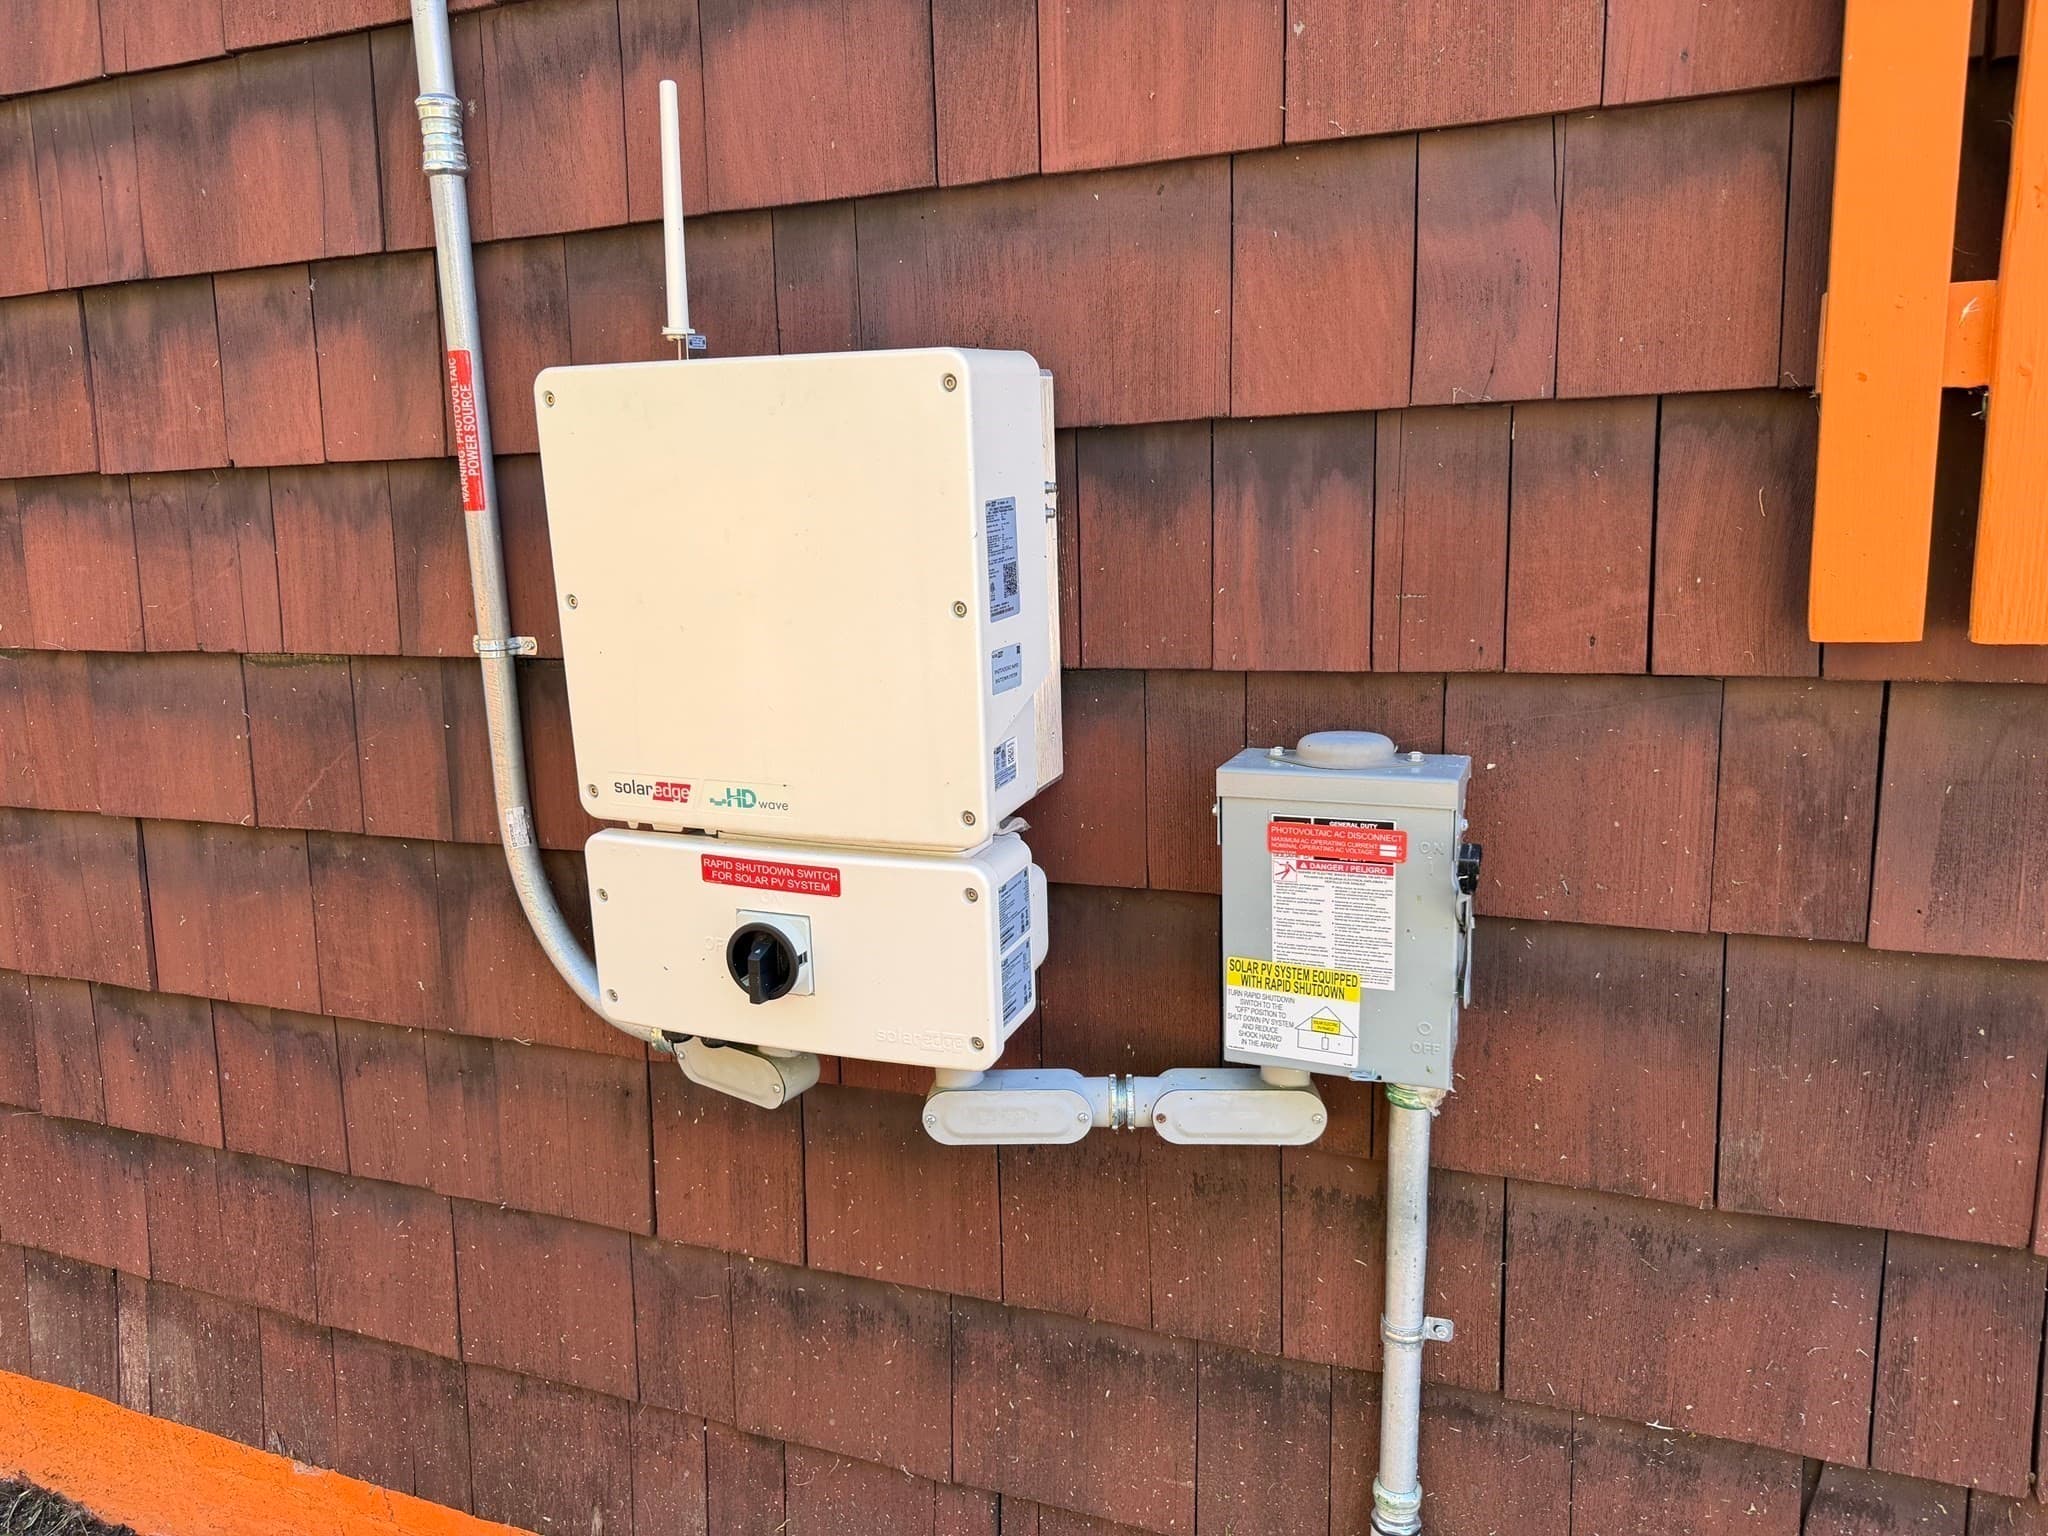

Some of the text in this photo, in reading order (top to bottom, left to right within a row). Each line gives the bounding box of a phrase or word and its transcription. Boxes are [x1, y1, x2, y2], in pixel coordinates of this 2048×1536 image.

[448, 357, 471, 502] WARNING: PHOTOVOLTAIC
[460, 383, 480, 476] POWER SOURCE
[758, 800, 789, 811] wave
[1329, 821, 1360, 829] GENERAL
[1271, 826, 1403, 843] PHOTOVOLTAIC AC DISCONNECT
[1298, 844, 1336, 853] OPERATING
[1311, 839, 1346, 848] OPERATING
[703, 859, 838, 881] RAPID SHUTDOWN SWITCH
[1309, 862, 1344, 872] DANGER
[1350, 865, 1387, 874] PELIGRO
[711, 870, 733, 881] FOR
[734, 874, 769, 885] SOLAR
[771, 877, 785, 887] PV
[787, 879, 830, 892] SYSTEM
[1229, 959, 1258, 974] SOLAR
[1260, 963, 1273, 977] PV
[1274, 965, 1310, 982] SYSTEM
[1312, 969, 1358, 988] EQUIPPED
[1240, 973, 1345, 1000] WITH RAPID SHUTDOWN
[1228, 988, 1295, 1004] TURN RAPID SHUTDOWN
[1240, 998, 1283, 1011] SWITCH TO THE
[1250, 1007, 1278, 1017] POSITION
[1278, 1011, 1287, 1019] TO
[1227, 1012, 1295, 1028] SHUT DOWN PV SYSTEM
[1242, 1023, 1279, 1034] AND REDUCE
[1238, 1030, 1283, 1043] SHOCK HAZARD
[1248, 1039, 1260, 1047] THE
[1260, 1041, 1279, 1050] ARRAY
